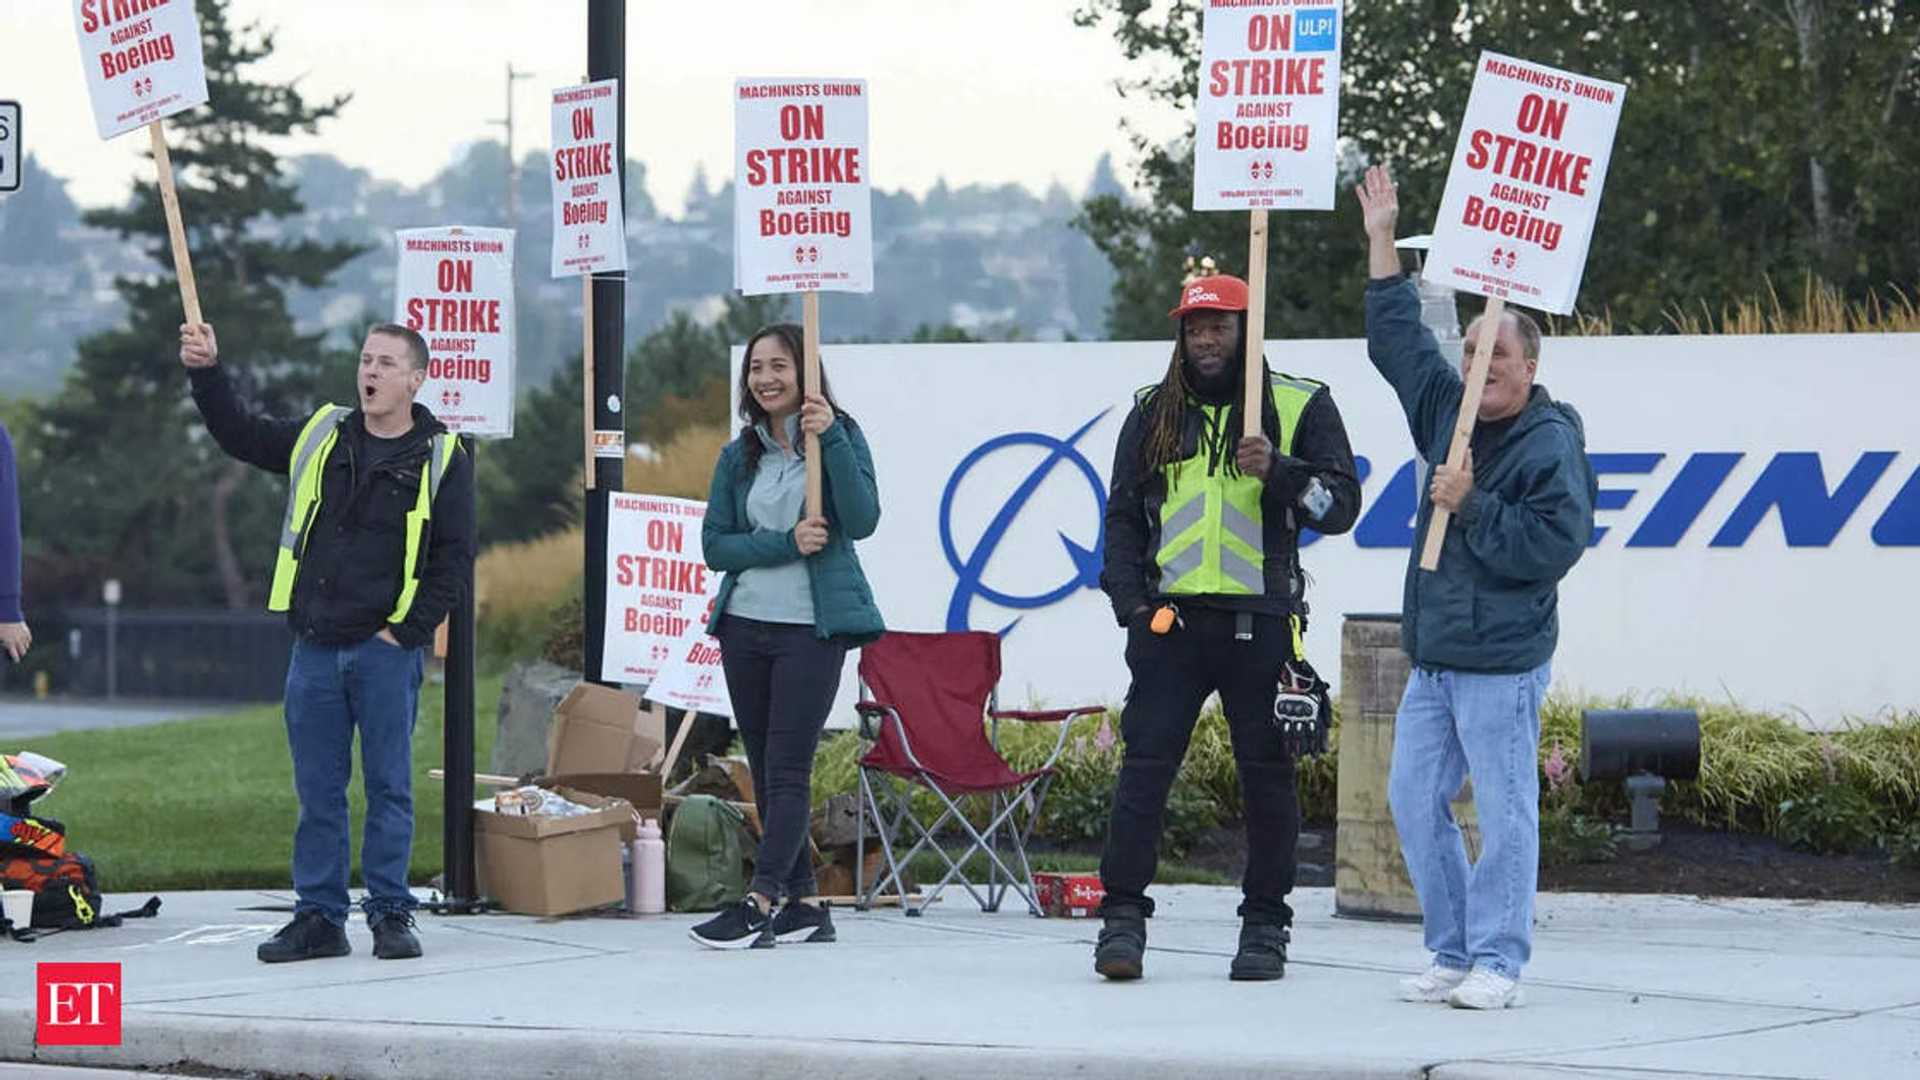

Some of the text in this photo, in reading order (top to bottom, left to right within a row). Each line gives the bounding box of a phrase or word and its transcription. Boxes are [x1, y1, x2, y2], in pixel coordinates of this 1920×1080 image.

[110, 18, 153, 45] AGAINST
[1247, 14, 1291, 52] ON
[1298, 18, 1333, 36] ULP!
[100, 33, 175, 79] Boeing
[740, 84, 861, 99] MACHINISTS UNION
[1209, 58, 1326, 97] STRIKE
[1485, 59, 1616, 105] MACHINISTS UNION
[572, 107, 594, 140] ON
[779, 104, 824, 141] ON
[1236, 102, 1293, 118] AGAINST
[1516, 93, 1568, 140] ON
[1217, 120, 1309, 152] Boeing
[555, 143, 612, 181] STRIKE
[746, 148, 860, 186] STRIKE
[1466, 129, 1592, 196] STRIKE
[571, 182, 599, 198] AGAINST
[776, 190, 832, 206] AGAINST
[1490, 182, 1551, 211] AGAINST
[563, 198, 609, 226] Boeing
[760, 208, 851, 238] Boeing
[1462, 195, 1563, 251] Boeing
[407, 240, 471, 252] MACHINISTS
[437, 259, 473, 293] ON
[407, 298, 500, 334] STRIKE
[430, 338, 476, 353] AGAINST
[429, 354, 491, 383] oeing
[615, 497, 683, 514] MACHINISTS
[647, 519, 684, 554] ON
[616, 554, 707, 595] STRIKE
[640, 593, 683, 611] AGAINST
